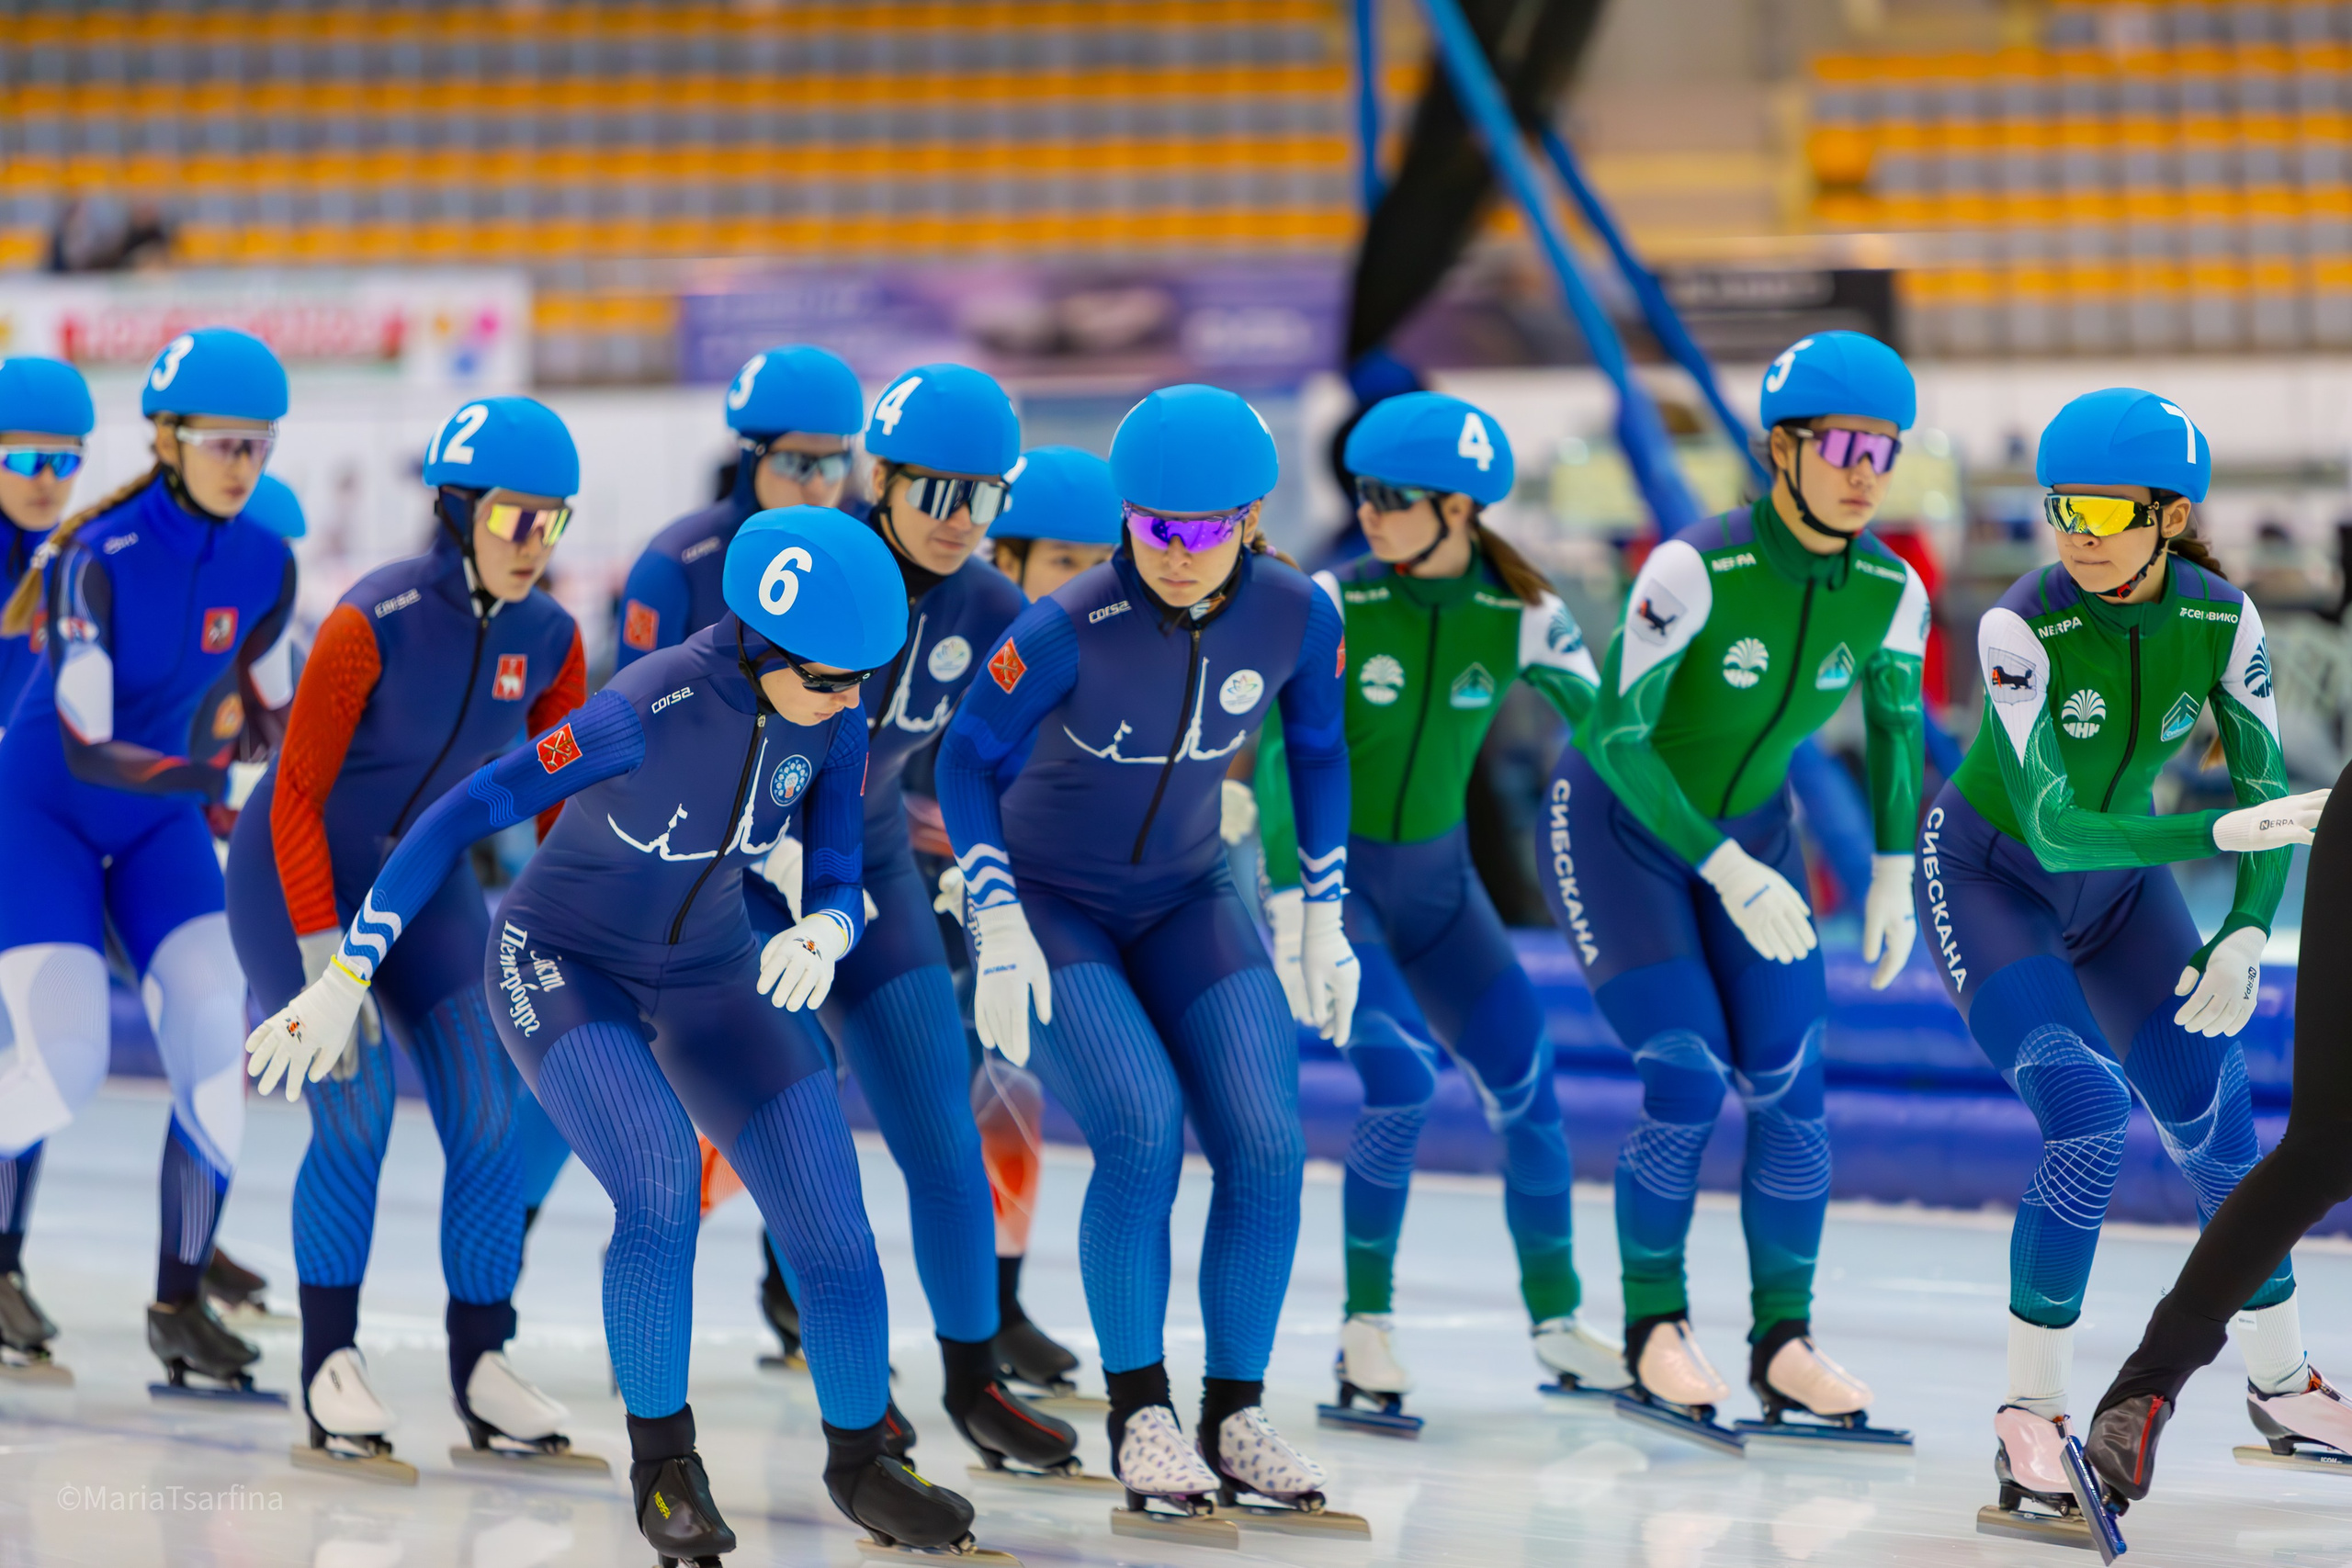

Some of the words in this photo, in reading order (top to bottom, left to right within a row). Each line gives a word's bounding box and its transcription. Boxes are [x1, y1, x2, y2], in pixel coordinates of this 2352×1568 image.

[151, 334, 195, 392] 3
[729, 354, 768, 411] 3
[428, 404, 489, 466] 12
[1457, 413, 1495, 472] 4
[2159, 401, 2197, 465] 7
[759, 546, 813, 616] 6
[1088, 600, 1132, 625] corsa
[2038, 616, 2083, 639] NERPA
[650, 686, 695, 715] corsa
[2259, 818, 2295, 831] NERPA
[1550, 778, 1600, 966] СИБСКАНА
[1923, 807, 1968, 993] СИБСКАНА
[2243, 965, 2258, 1001] NERPA
